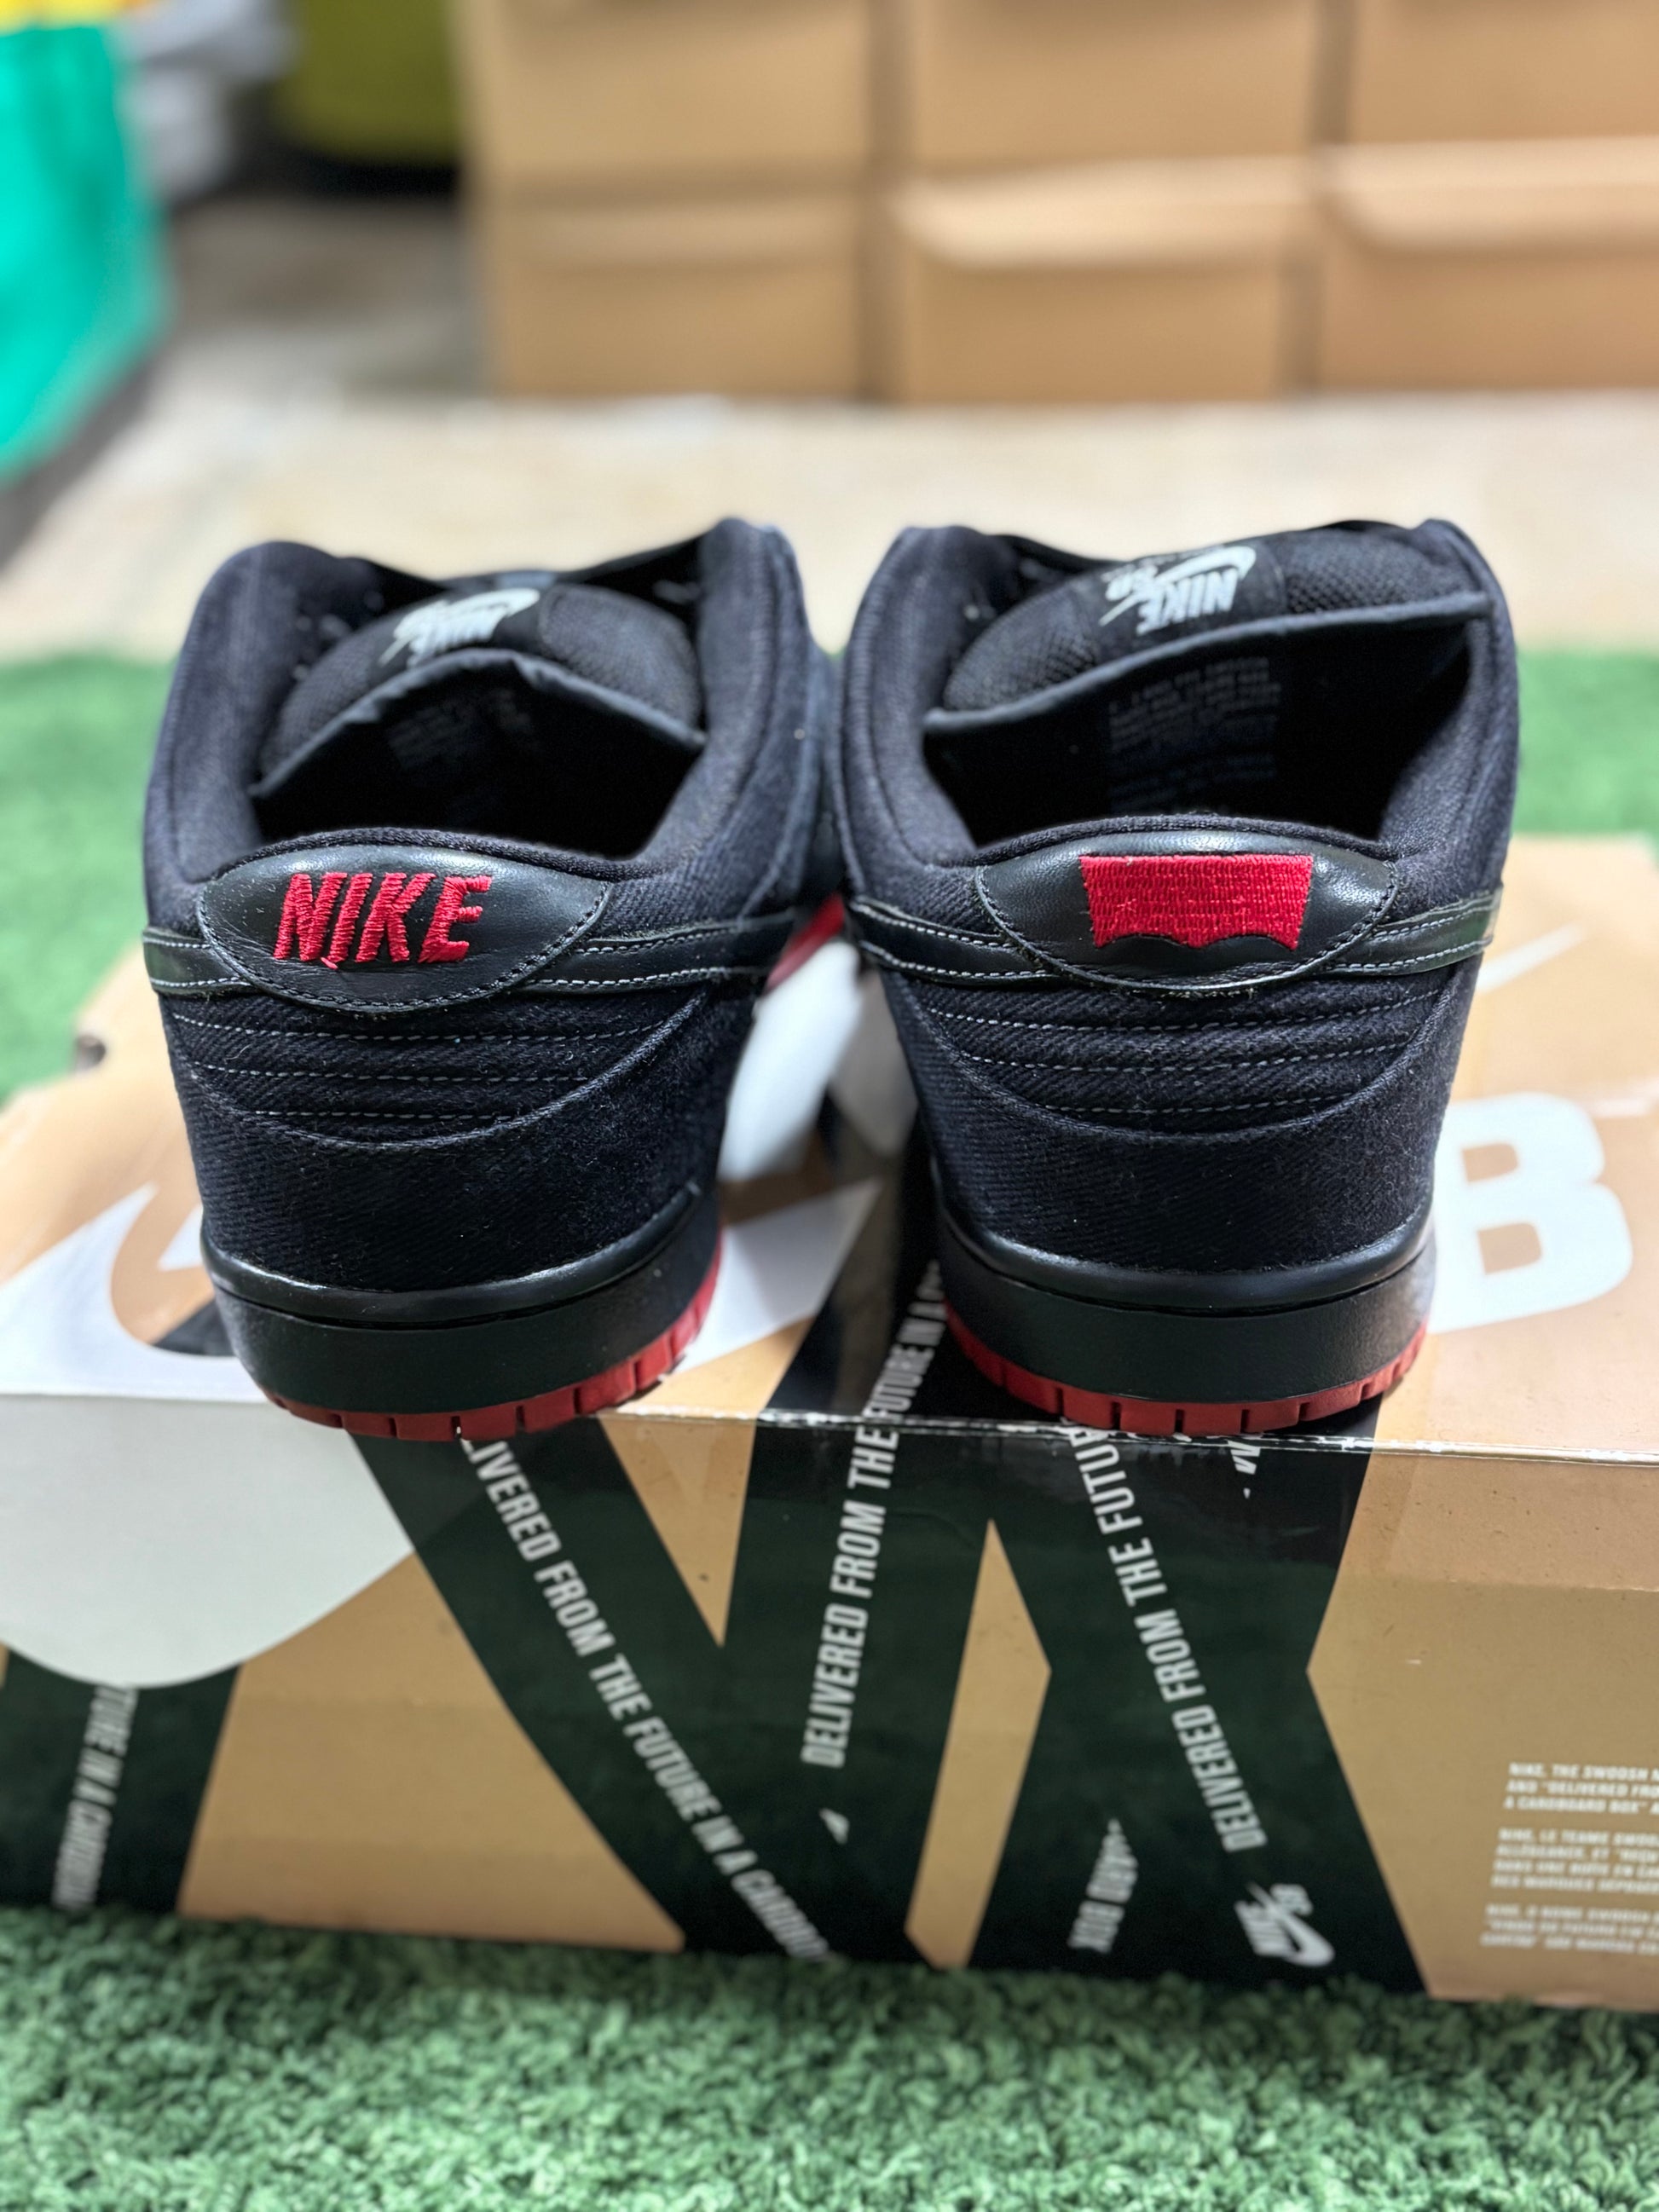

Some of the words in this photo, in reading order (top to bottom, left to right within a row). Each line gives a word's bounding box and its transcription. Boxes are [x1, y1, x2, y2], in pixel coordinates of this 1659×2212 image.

[273, 872, 493, 970] NIKE
[861, 1343, 935, 1421] FUTURE
[847, 1424, 899, 1490] THE
[1066, 1424, 1144, 1535] FUTUR
[829, 1500, 887, 1599] FROM
[1107, 1537, 1168, 1607] THE
[801, 1603, 869, 1768] DELIVERED
[1134, 1608, 1206, 1703] FROM
[533, 1560, 617, 1657] FROM
[588, 1653, 653, 1721] THE
[621, 1716, 723, 1822] FUTURE
[691, 1815, 745, 1854] IN
[1171, 1705, 1268, 1853] DELIVERED
